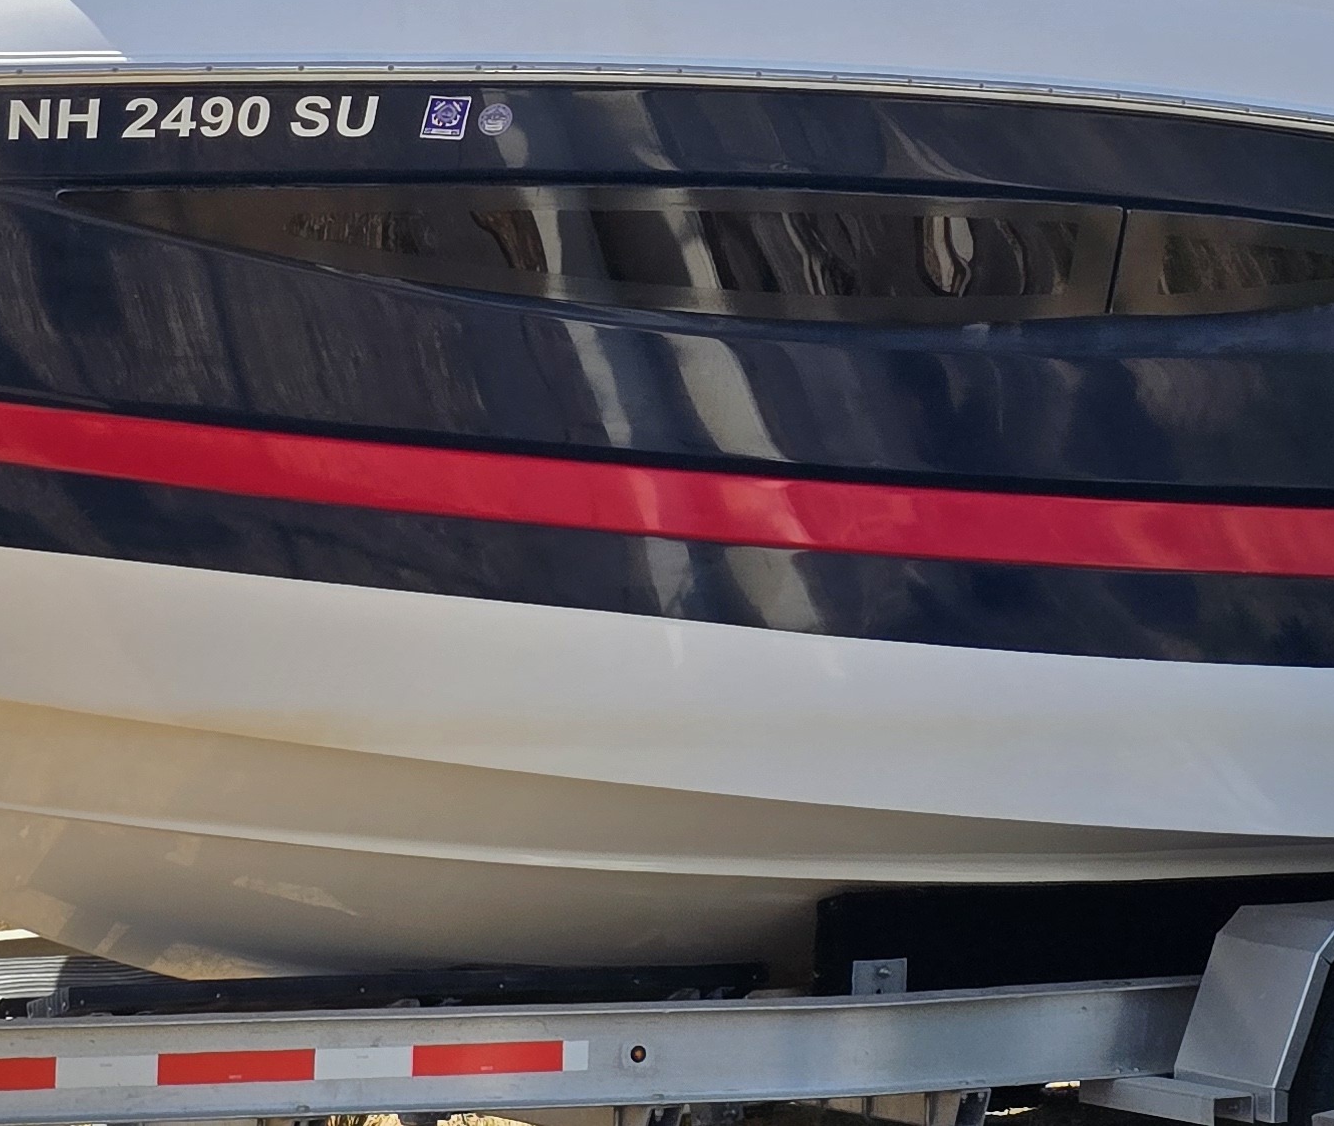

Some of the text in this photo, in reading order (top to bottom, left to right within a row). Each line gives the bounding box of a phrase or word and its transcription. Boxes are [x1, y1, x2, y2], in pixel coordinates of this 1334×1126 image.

[8, 94, 380, 140] NH 2490 SU
